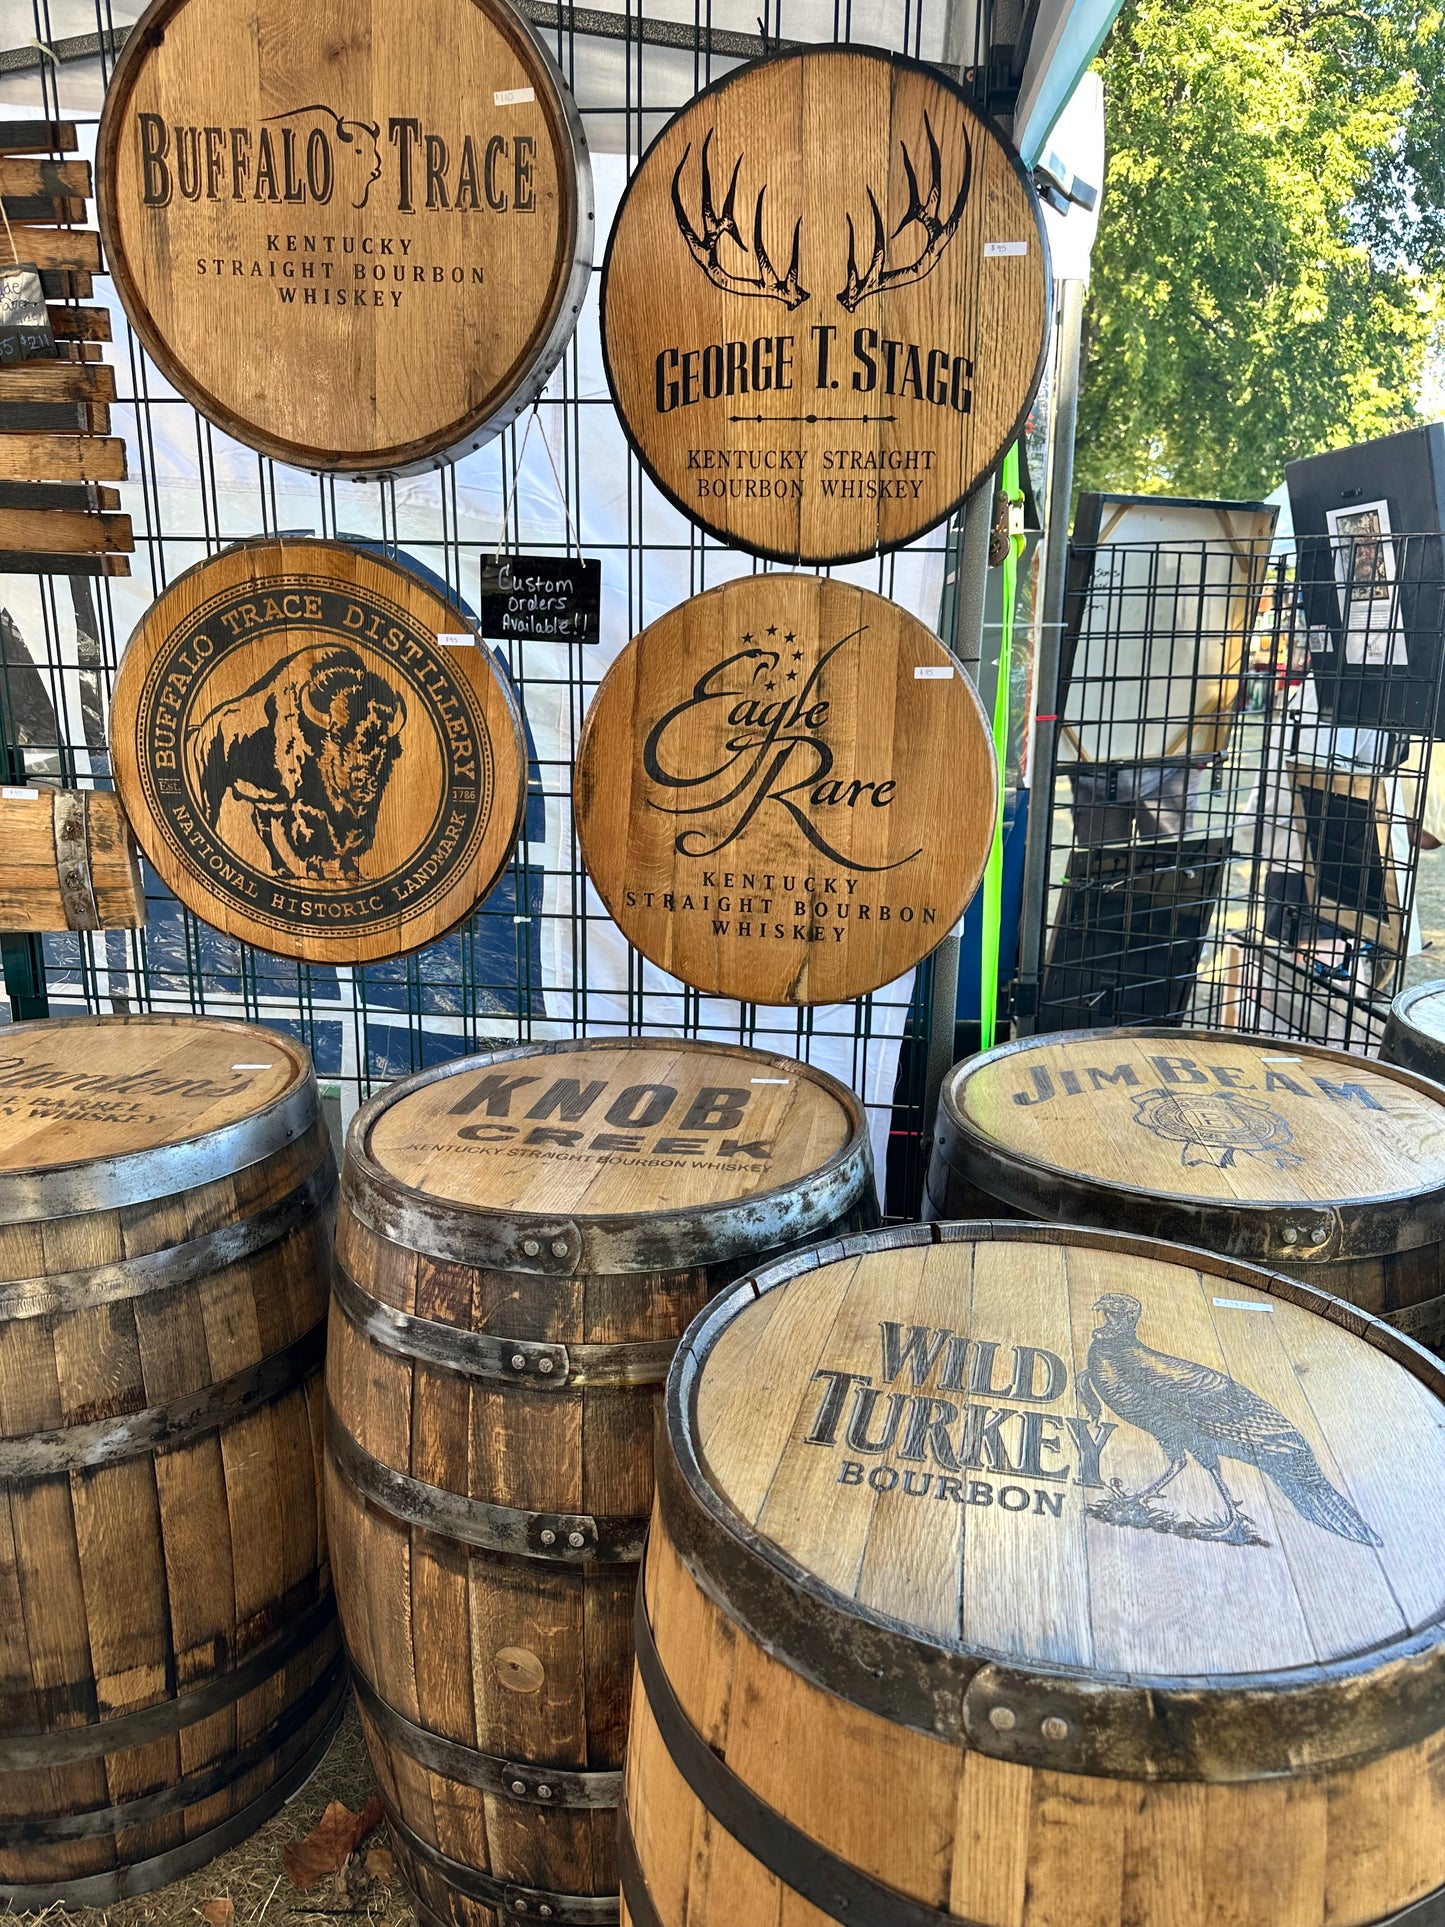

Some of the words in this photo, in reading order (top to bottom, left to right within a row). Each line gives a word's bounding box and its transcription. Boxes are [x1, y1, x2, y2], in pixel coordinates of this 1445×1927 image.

[138, 112, 335, 209] BUFFALO
[388, 117, 537, 214] TRACE
[266, 234, 413, 256] KENTUCKY
[196, 258, 334, 280] STRAIGHT
[353, 262, 486, 284] BOURBON
[278, 286, 403, 308] WHISKEY
[655, 335, 794, 414] GEORGE
[811, 325, 839, 389] T.
[852, 327, 974, 414] STAGG
[687, 449, 809, 470] KENTUCKY
[822, 450, 936, 470] STRAIGHT
[697, 478, 805, 499] BOURBON
[821, 479, 924, 500] WHISKEY
[498, 563, 574, 594] Custom
[502, 612, 588, 640] Available!!
[154, 634, 214, 770] BUFFALO
[220, 594, 323, 636] TRACE
[342, 603, 476, 780] DISTILLERY
[643, 625, 870, 815] Eagle
[452, 789, 476, 800] 1786
[675, 734, 923, 873] Rare
[172, 804, 259, 899] NATIONAL
[270, 893, 384, 920] HISTORIC
[391, 809, 467, 902] LANDMARK
[702, 871, 859, 895] KENTUCKY
[626, 891, 773, 913] STRAIGHT
[794, 901, 937, 924] BOURBON
[712, 919, 846, 943] WHISKEY
[1012, 1063, 1143, 1106] JIM
[1145, 1055, 1388, 1112] BEAM
[28, 1097, 145, 1112] BARREL
[28, 1109, 166, 1124] WHISKEY
[447, 1074, 753, 1132] KNOB
[456, 1123, 774, 1160] CREEK
[406, 1143, 506, 1157] KENTUCKY
[504, 1147, 596, 1163] STRAIGHT
[596, 1155, 688, 1169] BOURBON
[691, 1160, 772, 1174] WHISKEY
[878, 1320, 1068, 1404] WILD
[836, 1460, 1066, 1519] BOURBON
